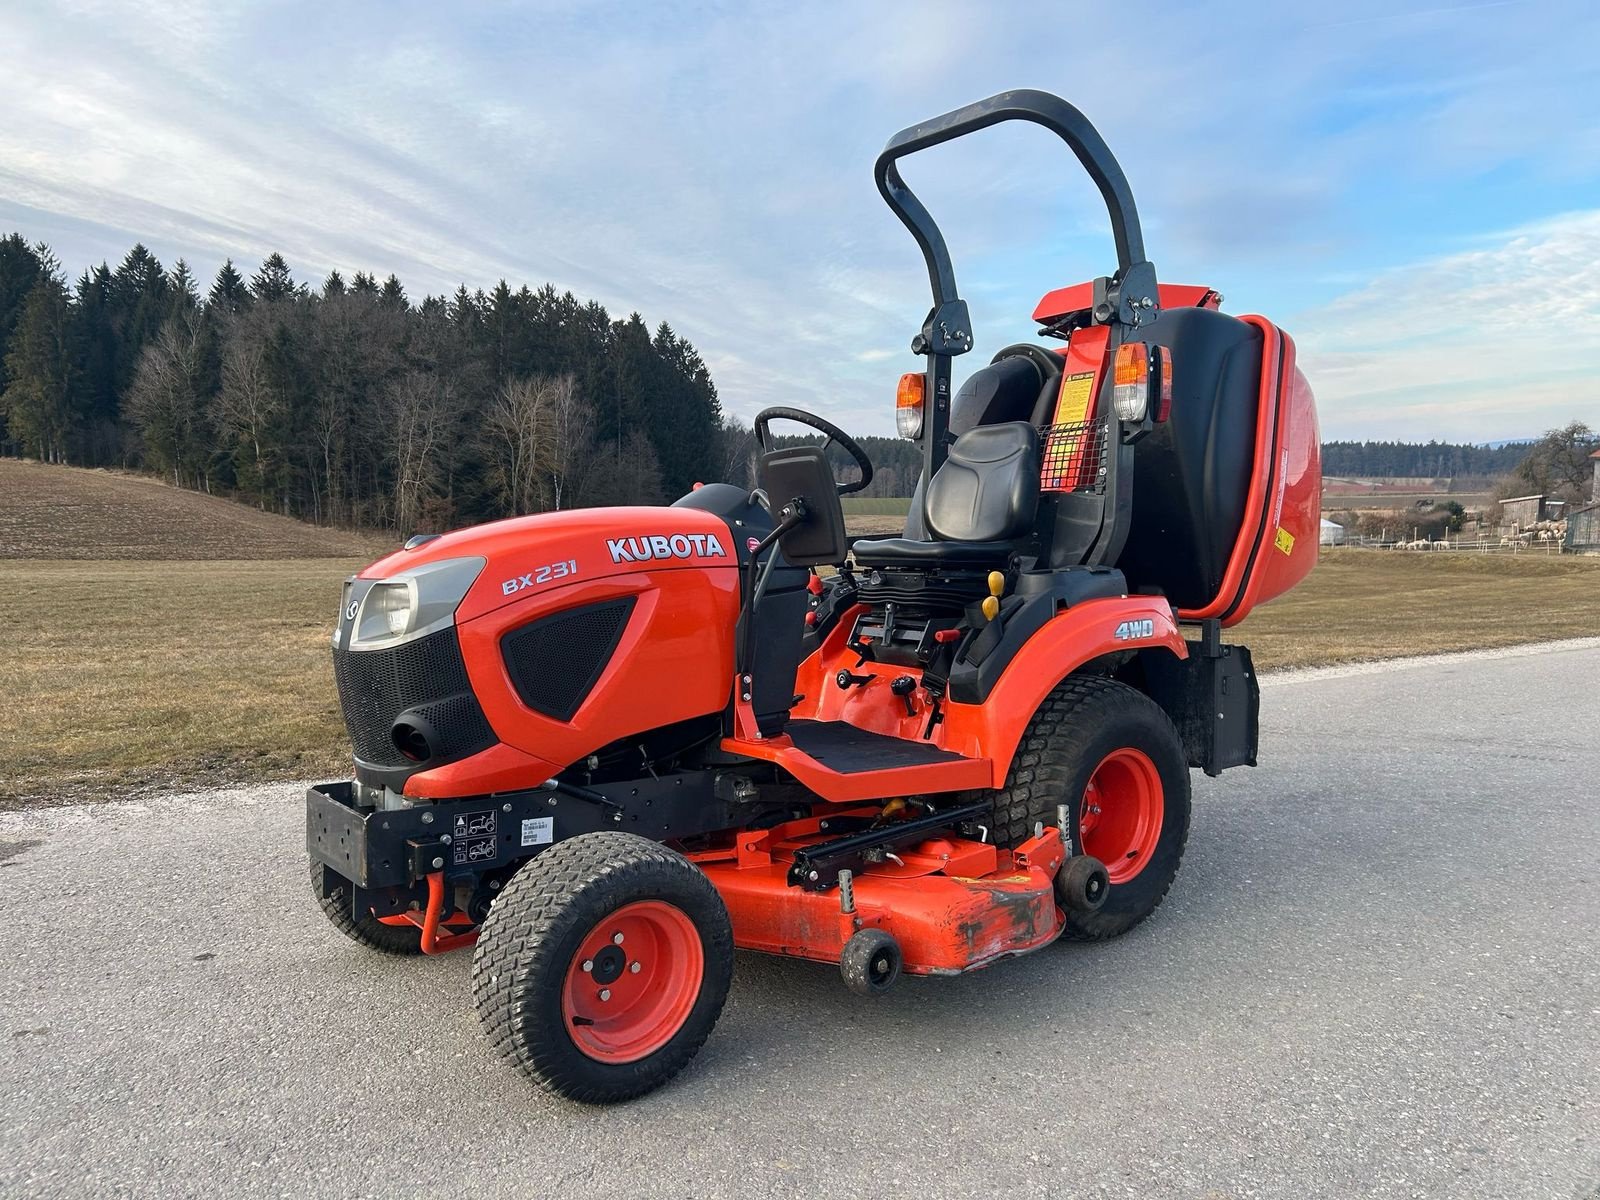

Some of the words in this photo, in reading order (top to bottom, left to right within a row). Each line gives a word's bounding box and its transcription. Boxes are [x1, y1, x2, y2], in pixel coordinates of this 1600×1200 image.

[606, 534, 726, 563] KUBOTA
[502, 559, 577, 596] BX231
[1114, 619, 1154, 641] 4WD
